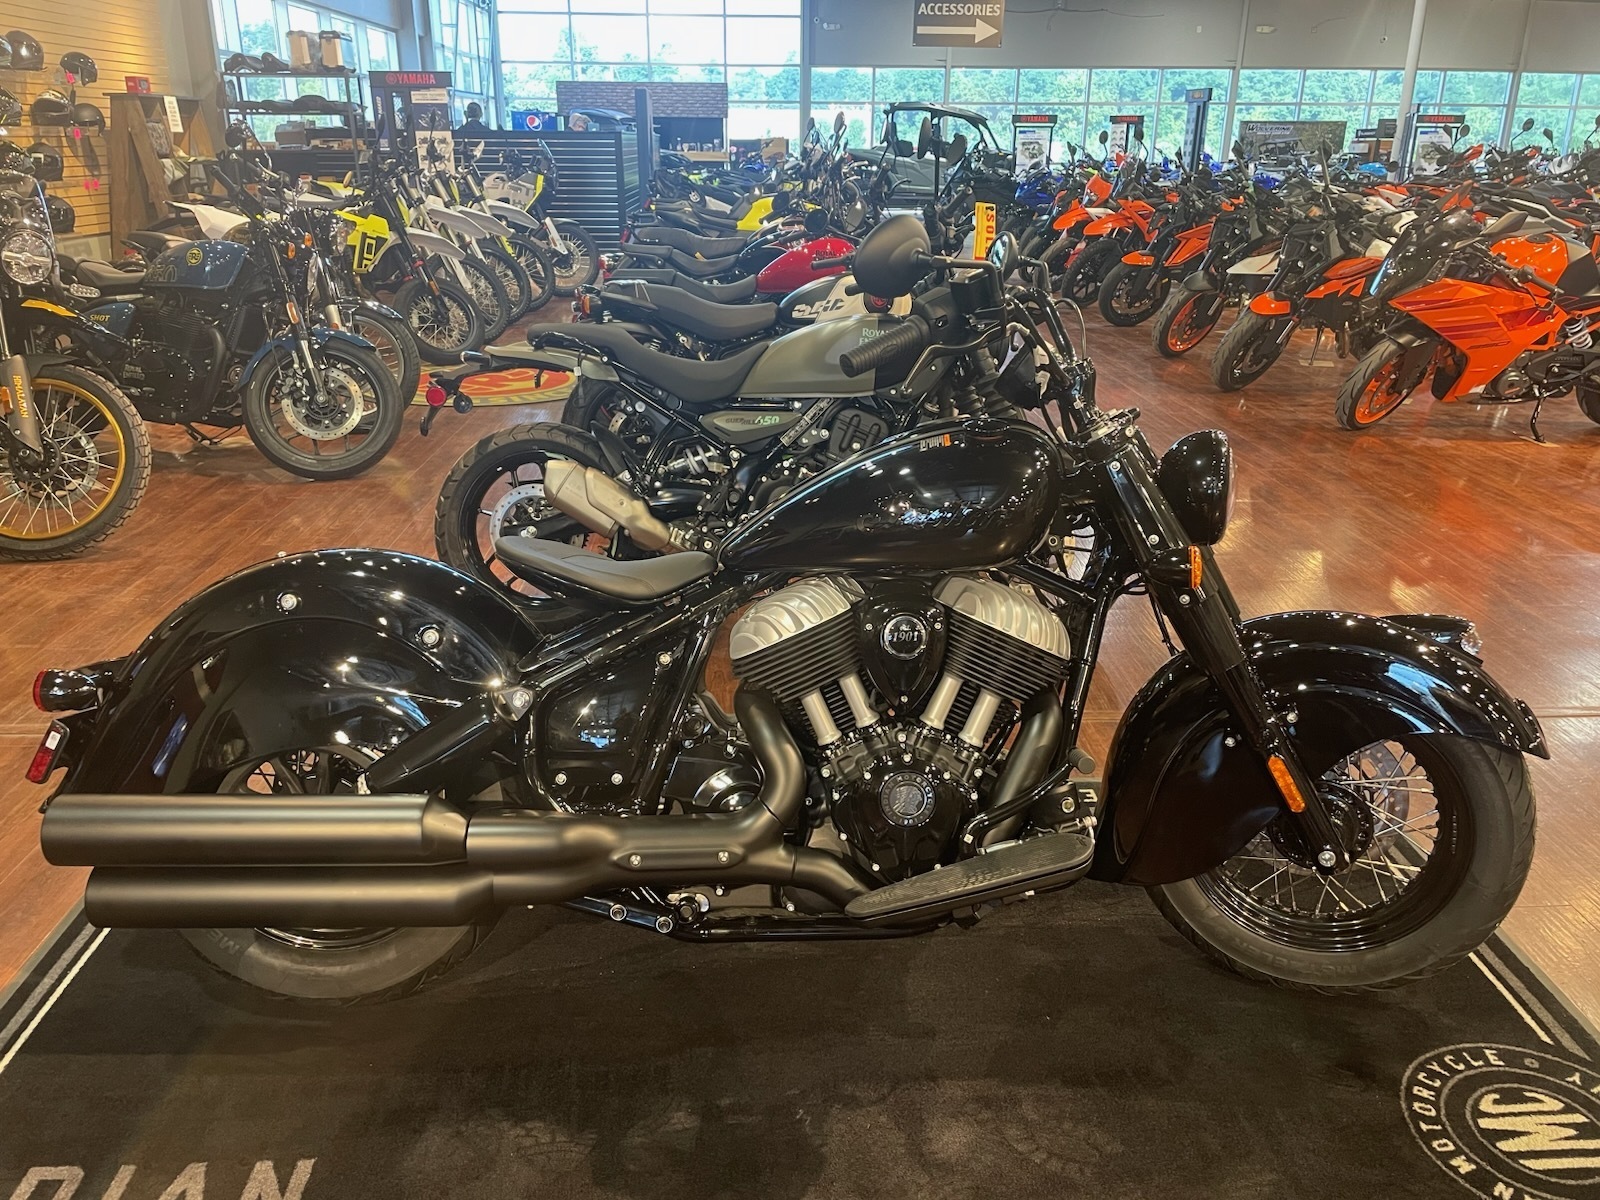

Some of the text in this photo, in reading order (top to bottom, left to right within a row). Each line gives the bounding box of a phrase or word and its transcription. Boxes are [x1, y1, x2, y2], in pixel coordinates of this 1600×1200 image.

[918, 3, 1001, 16] ACCESSORIES
[396, 73, 436, 84] YAMAHA
[862, 327, 889, 338] ROYA
[12, 375, 29, 418] HIMALAYAN
[754, 415, 780, 425] 450
[893, 631, 919, 642] 1901
[1412, 1048, 1506, 1175] MOTORCYCLE
